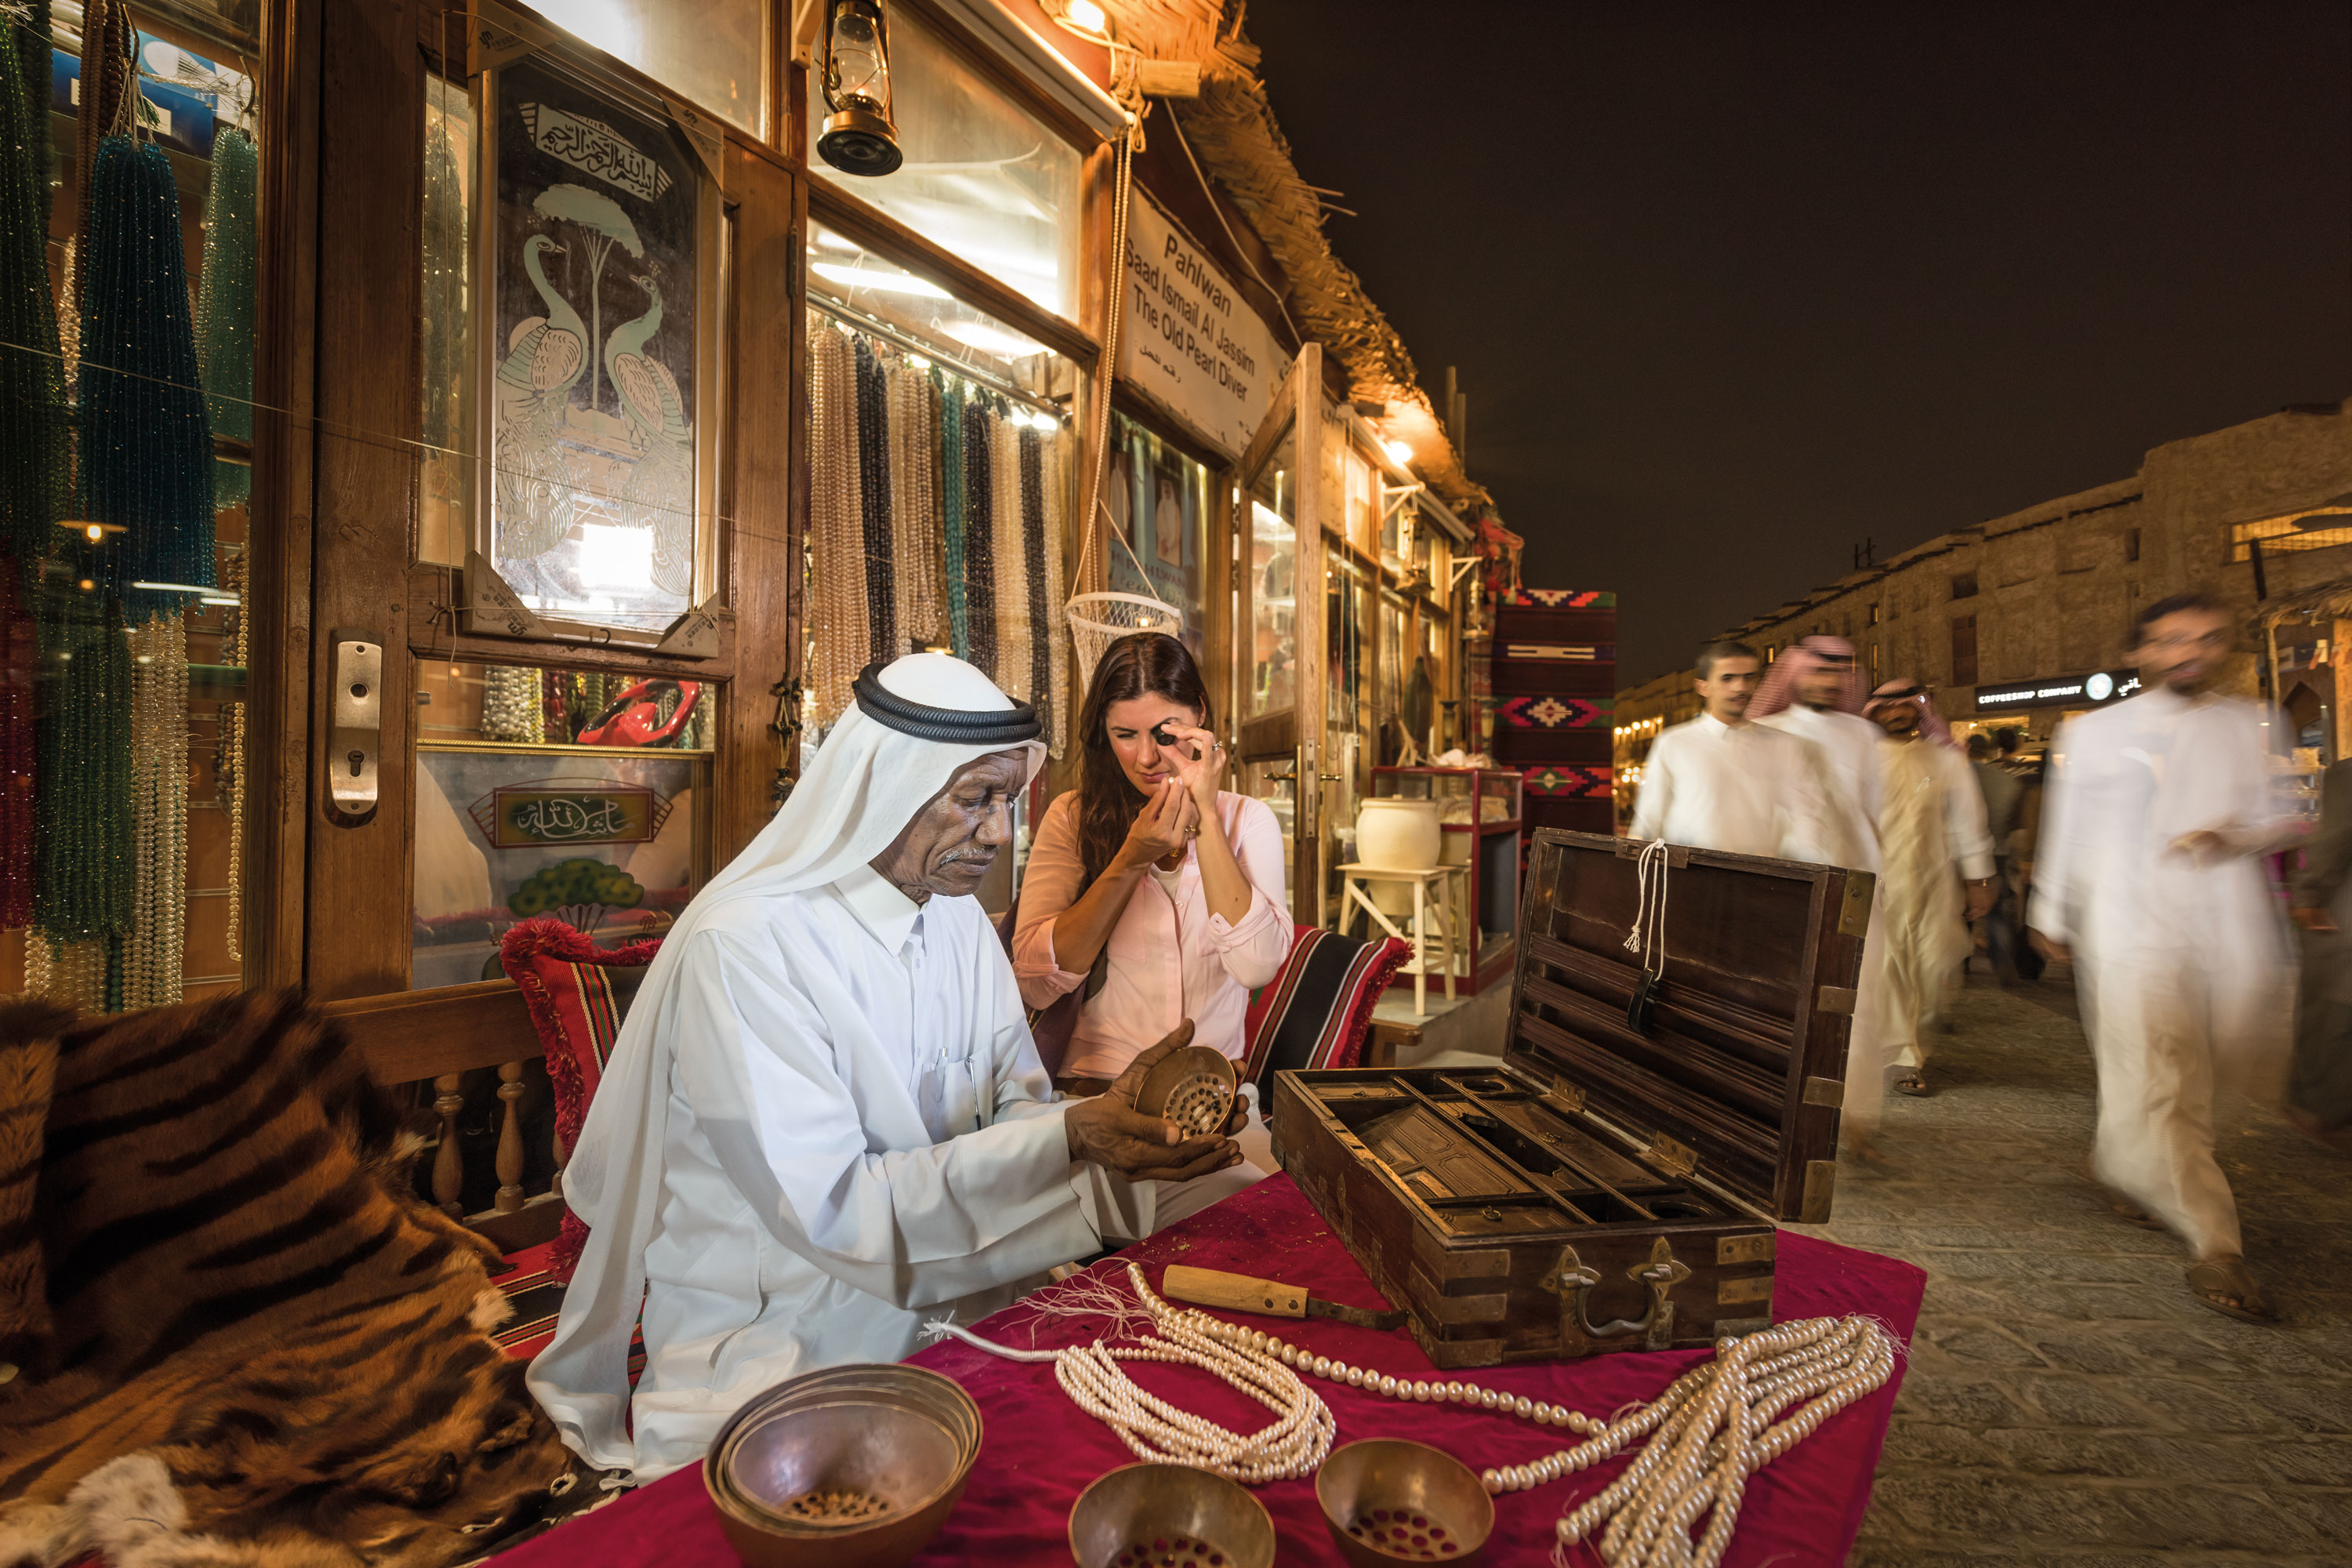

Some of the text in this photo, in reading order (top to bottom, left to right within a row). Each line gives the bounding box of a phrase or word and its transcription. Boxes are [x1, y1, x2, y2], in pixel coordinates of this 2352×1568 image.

[1164, 234, 1232, 318] Pahlwan
[1134, 283, 1158, 329] The
[1162, 314, 1184, 351] Old
[1186, 338, 1217, 380] Pearl
[1219, 362, 1248, 402] Diver
[1162, 280, 1200, 332] Ismail
[1200, 317, 1215, 343] Al
[1217, 328, 1255, 377] Jassim
[1979, 684, 2082, 704] COFFEESHOP COMPANY
